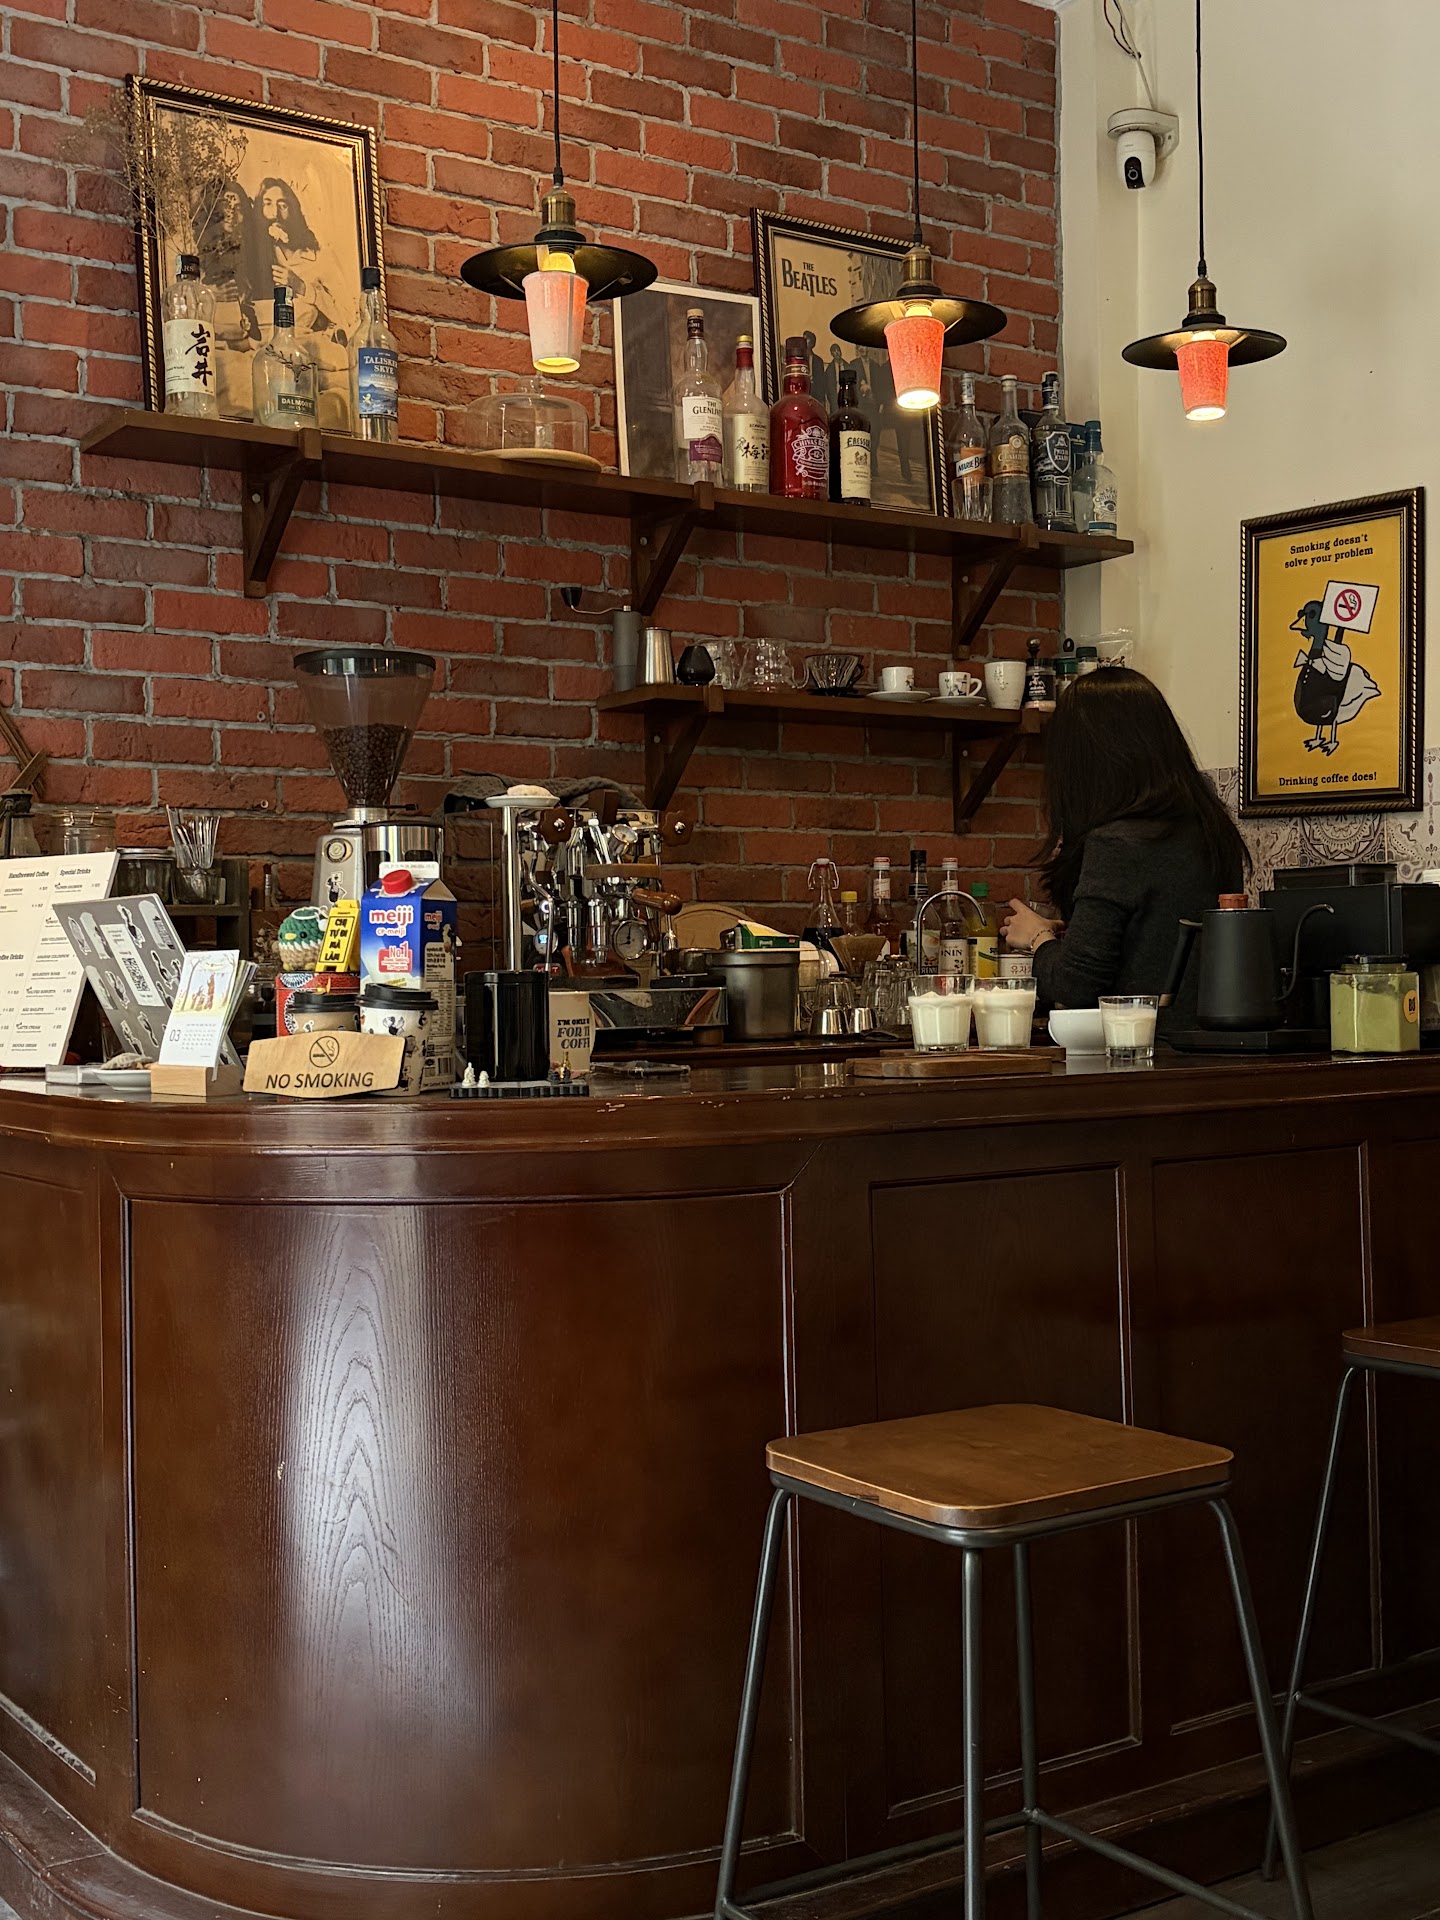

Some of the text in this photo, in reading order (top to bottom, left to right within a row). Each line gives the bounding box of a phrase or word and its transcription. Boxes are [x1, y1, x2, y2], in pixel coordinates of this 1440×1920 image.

[803, 262, 815, 271] THE
[781, 257, 838, 297] BEATLES
[184, 323, 213, 387] 岩井
[374, 365, 394, 375] SKYE
[281, 397, 313, 410] DALMORE
[958, 461, 974, 473] MARIE
[1290, 534, 1368, 554] Smoking doesn't
[1284, 547, 1374, 568] solve your problem
[1279, 771, 1377, 787] Drinking coffee does!
[60, 869, 76, 877] Special
[370, 906, 413, 925] meiji
[376, 927, 405, 937] CP-meiji
[169, 1029, 181, 1041] 03
[557, 1026, 582, 1038] FOR
[265, 1072, 374, 1089] NO SMOKING
